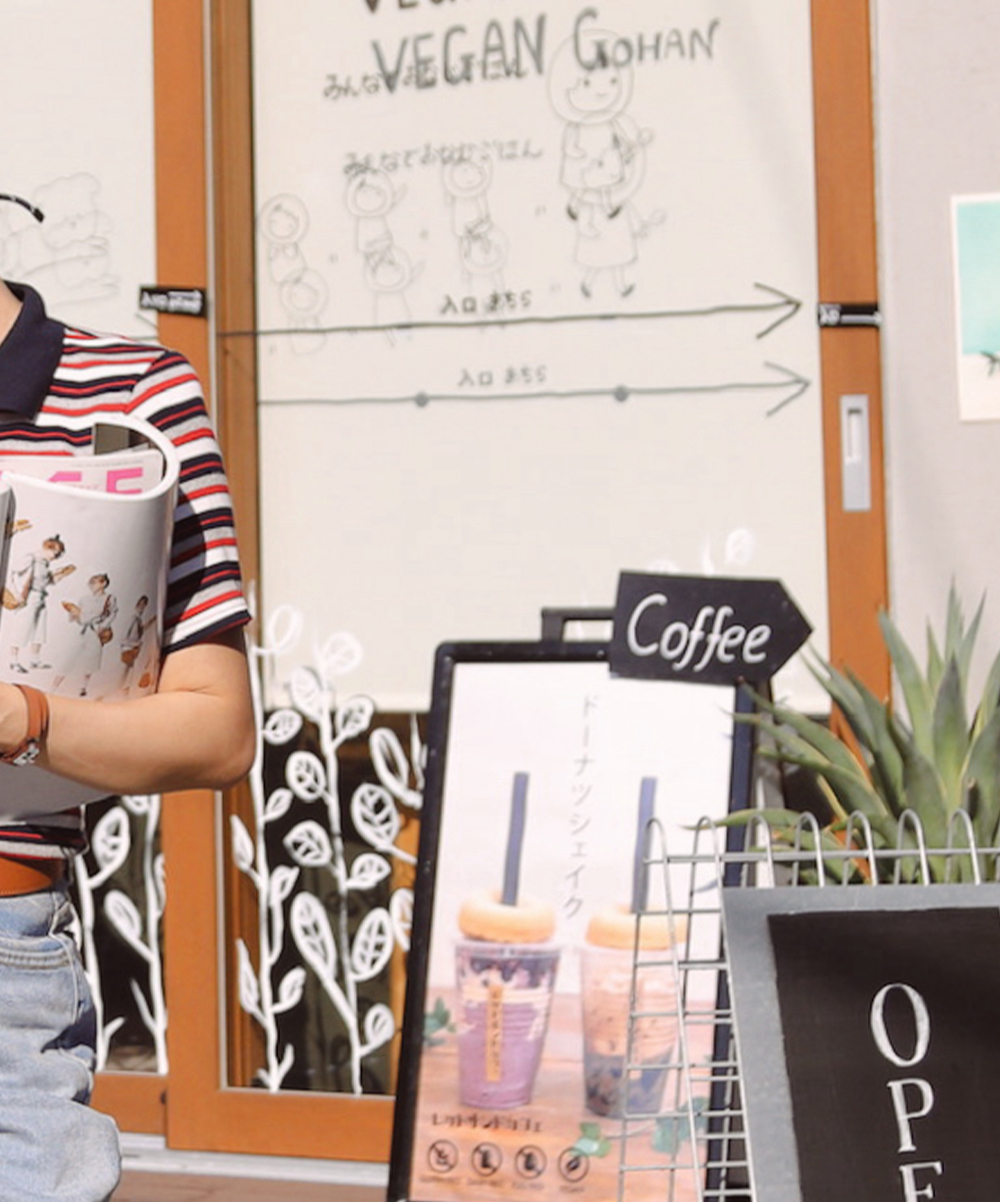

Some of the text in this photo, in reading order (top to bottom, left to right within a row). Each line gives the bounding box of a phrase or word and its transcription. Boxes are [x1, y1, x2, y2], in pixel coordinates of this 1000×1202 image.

[371, 13, 547, 93] VEGAN
[627, 593, 771, 672] Coffee
[562, 695, 600, 920] ドーナツシェイク
